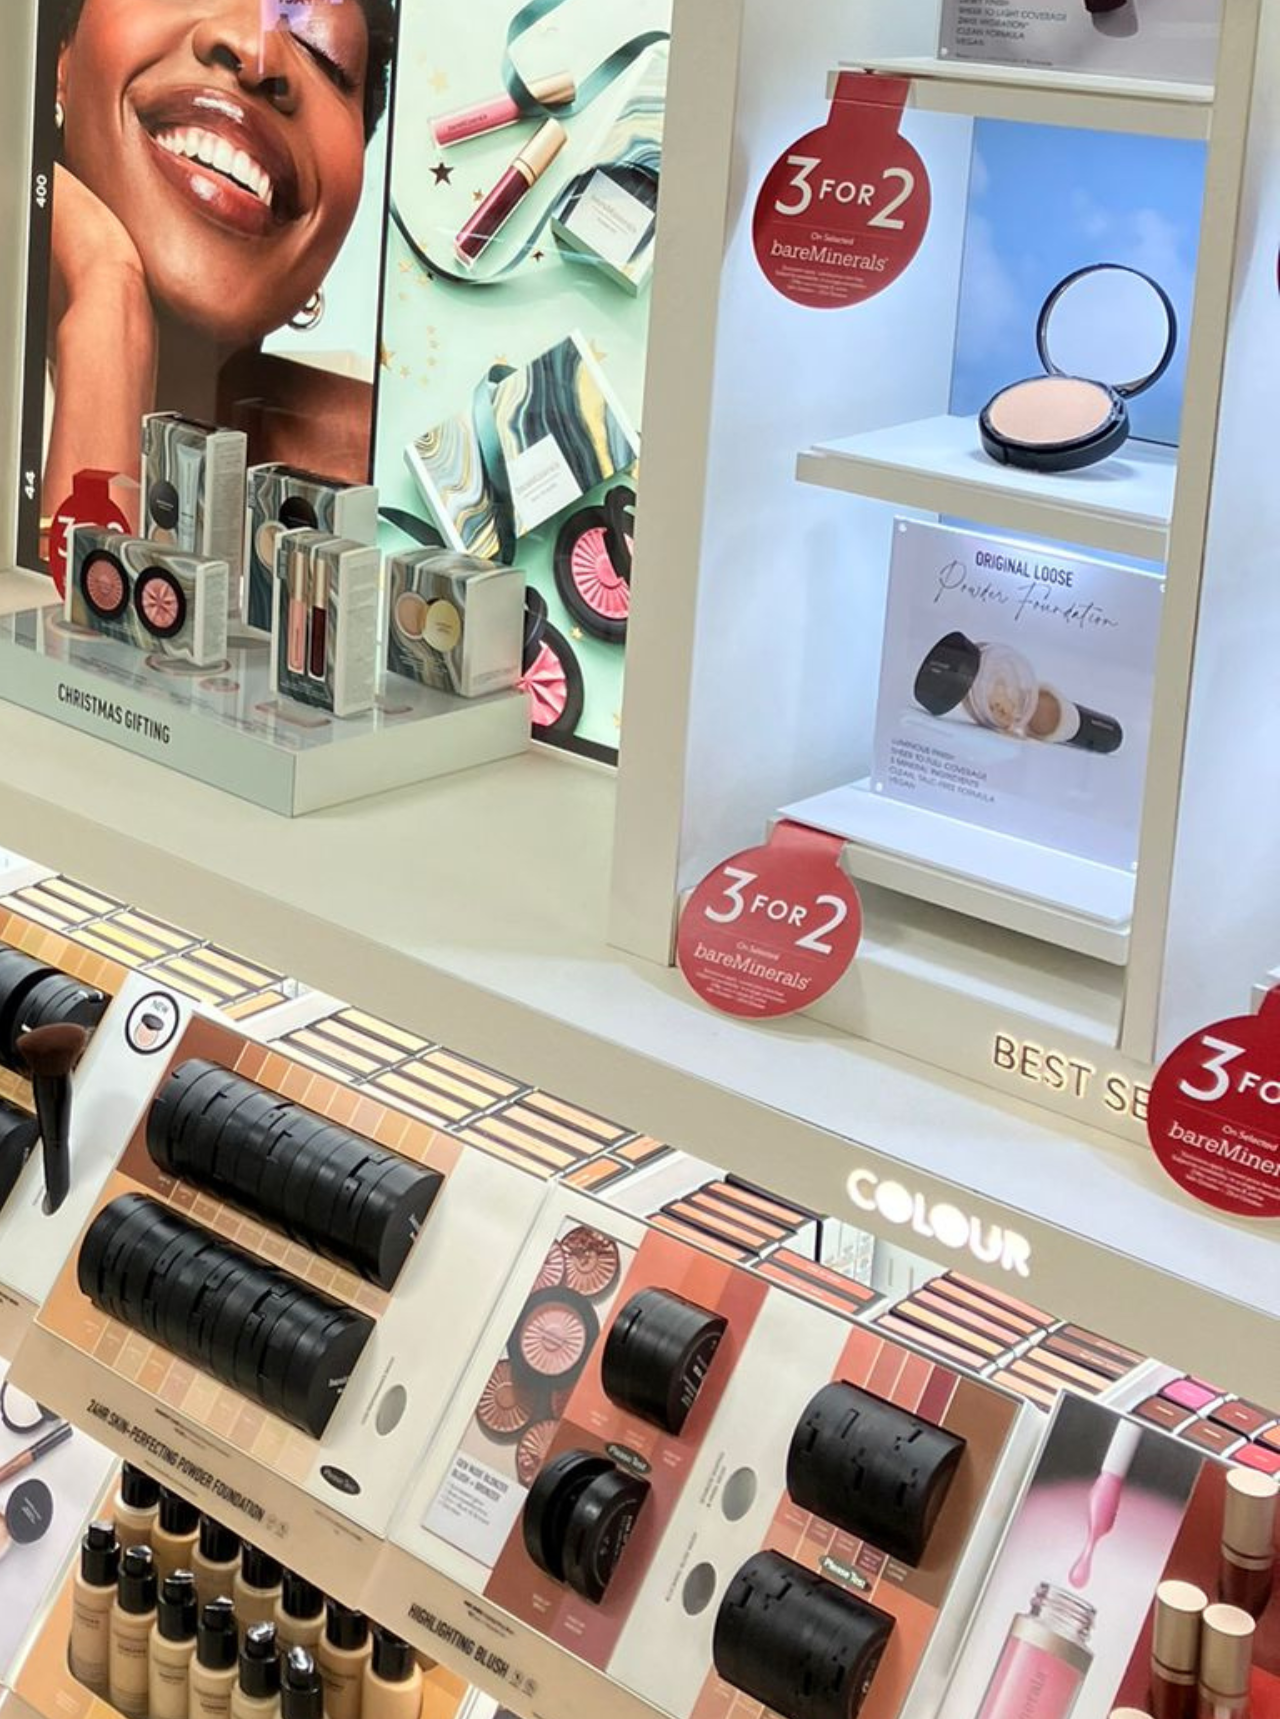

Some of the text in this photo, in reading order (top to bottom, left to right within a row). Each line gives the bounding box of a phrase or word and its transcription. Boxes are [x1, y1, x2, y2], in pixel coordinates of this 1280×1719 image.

[35, 173, 48, 209] 400
[774, 155, 915, 230] 3 FOR 2
[770, 239, 888, 272] bareMinerals
[24, 471, 36, 500] 44
[975, 550, 1074, 588] ORIGINAL LOOSE
[1014, 582, 1120, 630] Foundation
[58, 683, 171, 744] CHRISTMAS GIFTING
[704, 866, 847, 955] 3 FOR 2
[693, 942, 812, 991] bareMinerals
[993, 1035, 1091, 1097] BEST
[1178, 1035, 1247, 1102] 3
[846, 1168, 1031, 1278] COLOUR
[86, 1399, 110, 1423] 24HR
[107, 1411, 180, 1466] SKIN-PERFECTING
[176, 1456, 219, 1488] POWDER
[212, 1479, 266, 1521] FOUNDATION
[408, 1603, 476, 1656] HIGHLIGHTING
[473, 1645, 510, 1678] BLUSH
